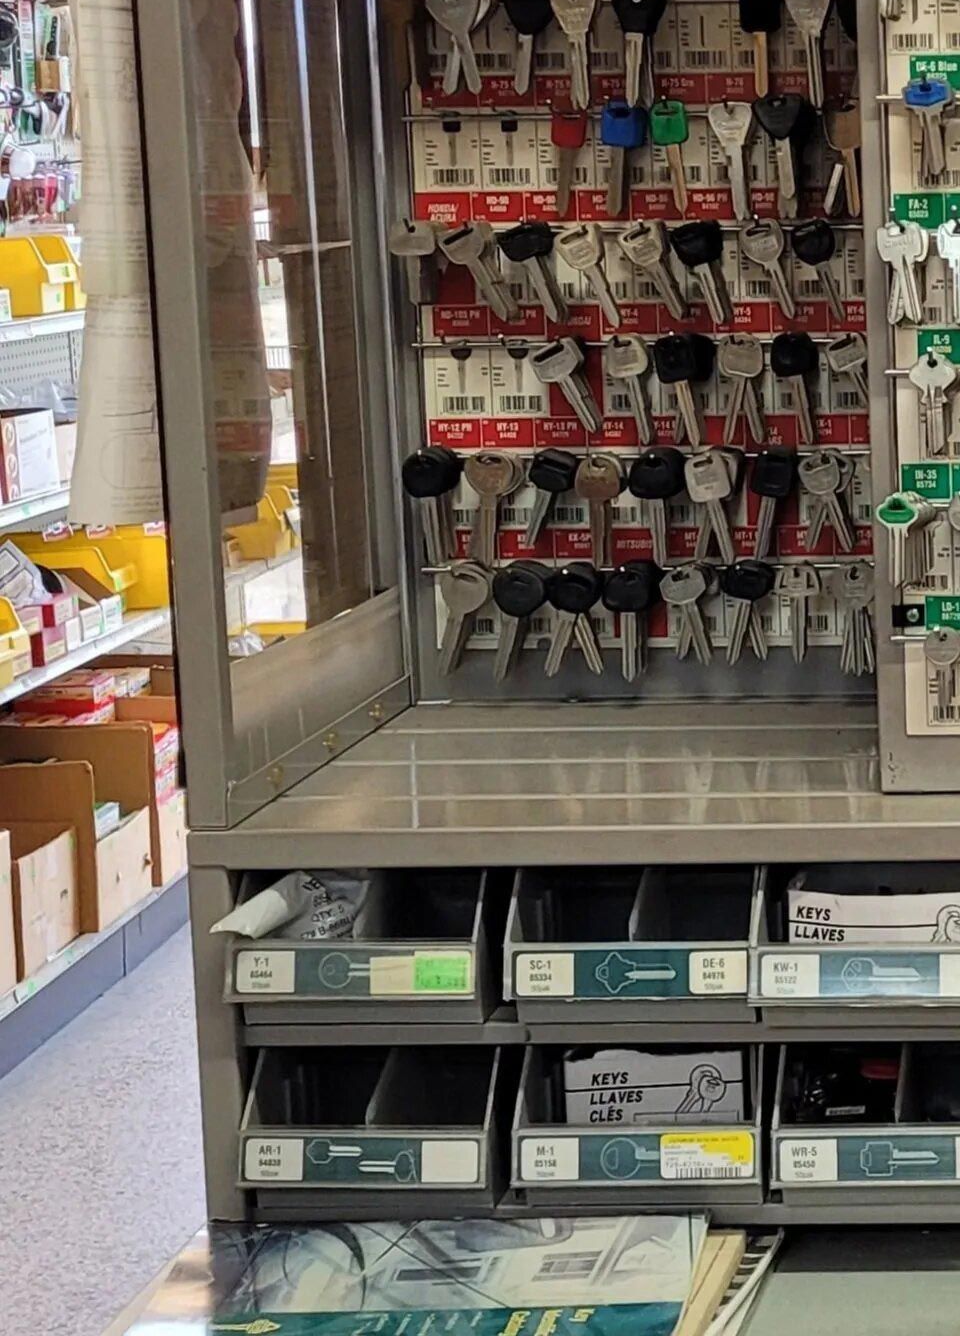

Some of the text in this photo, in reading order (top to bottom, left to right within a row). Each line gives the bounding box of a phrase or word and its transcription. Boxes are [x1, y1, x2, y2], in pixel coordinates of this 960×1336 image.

[796, 905, 831, 921] KEYS
[794, 925, 845, 942] LLAVES
[253, 957, 270, 968] Y-1
[529, 960, 552, 970] SC-1
[702, 957, 725, 968] DE-6
[773, 962, 799, 973] KW-1
[591, 1071, 629, 1086] KEYS
[589, 1090, 643, 1105] LLAVES
[589, 1107, 623, 1123] CLÉS
[258, 1145, 282, 1156] AR-1
[536, 1146, 555, 1155] M-1
[791, 1146, 817, 1157] WR-5
